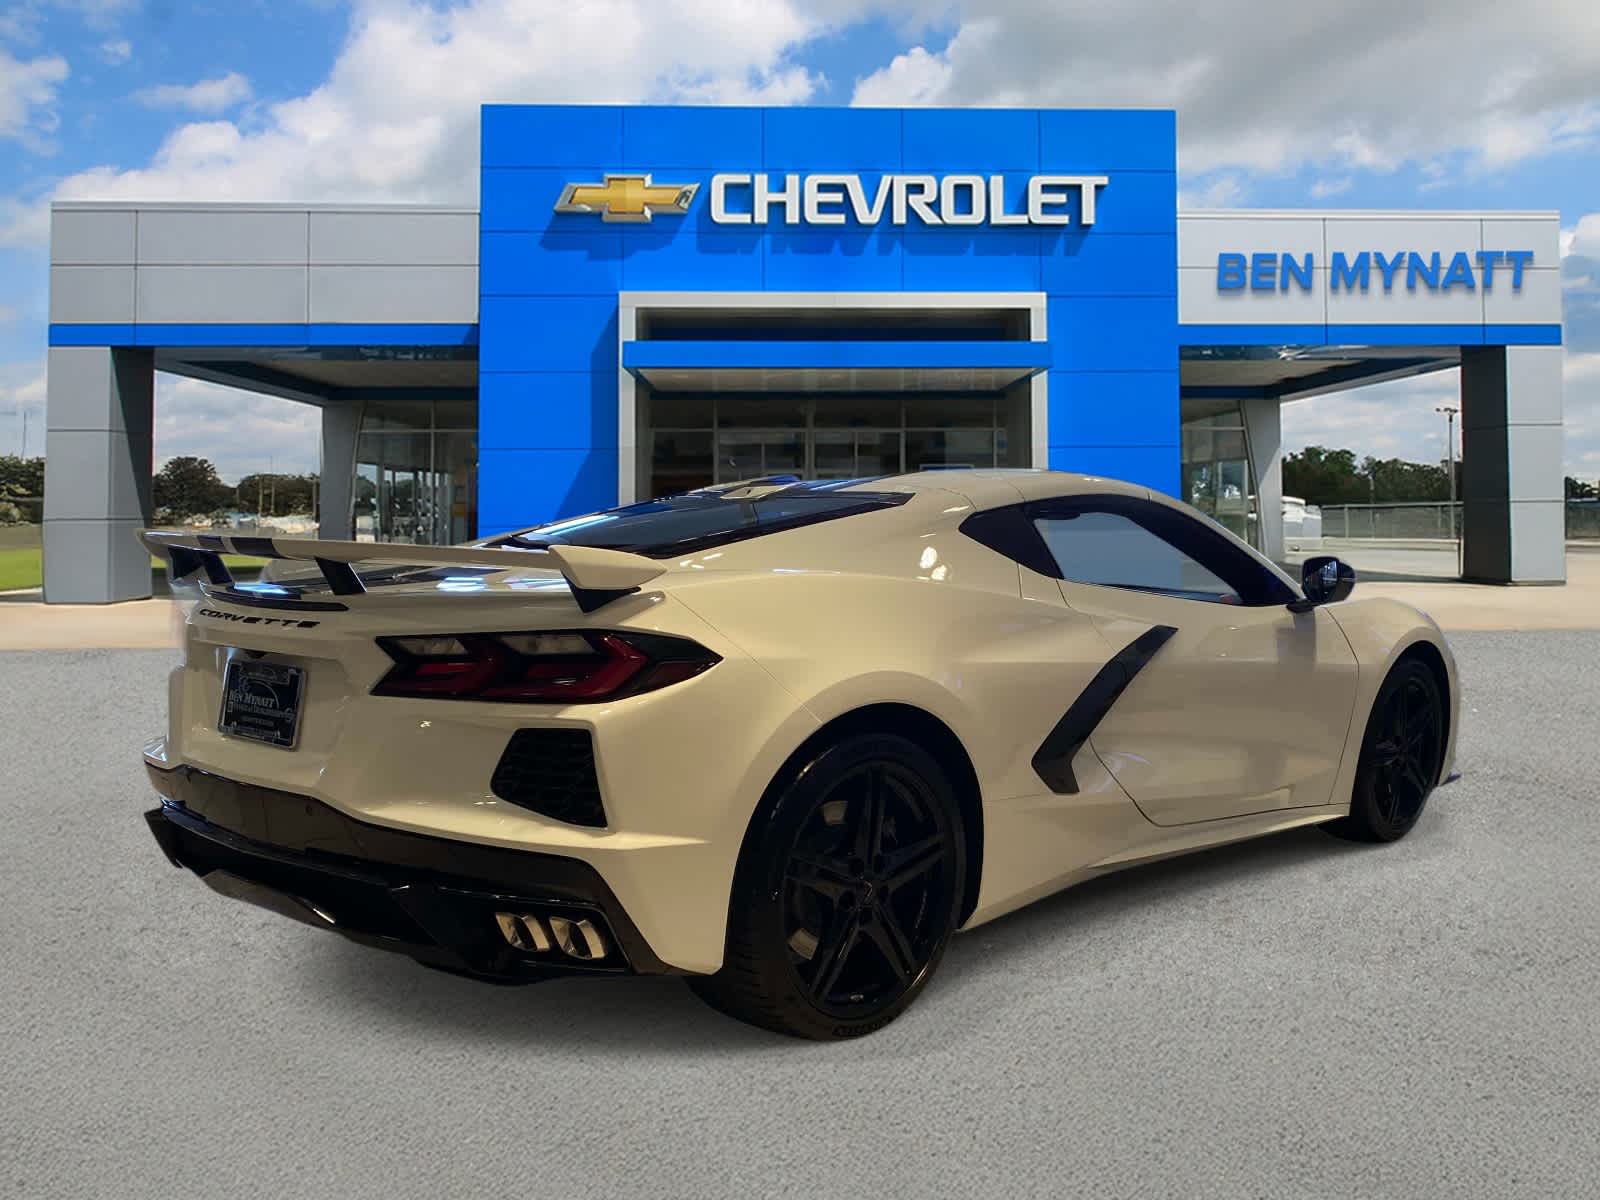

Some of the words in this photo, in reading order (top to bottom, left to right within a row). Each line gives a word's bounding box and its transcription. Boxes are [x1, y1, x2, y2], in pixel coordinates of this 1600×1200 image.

[710, 173, 1110, 225] CHEVROLET
[1217, 252, 1313, 291] BEN
[1330, 250, 1534, 290] MYNATT
[200, 608, 321, 629] CORVETTE
